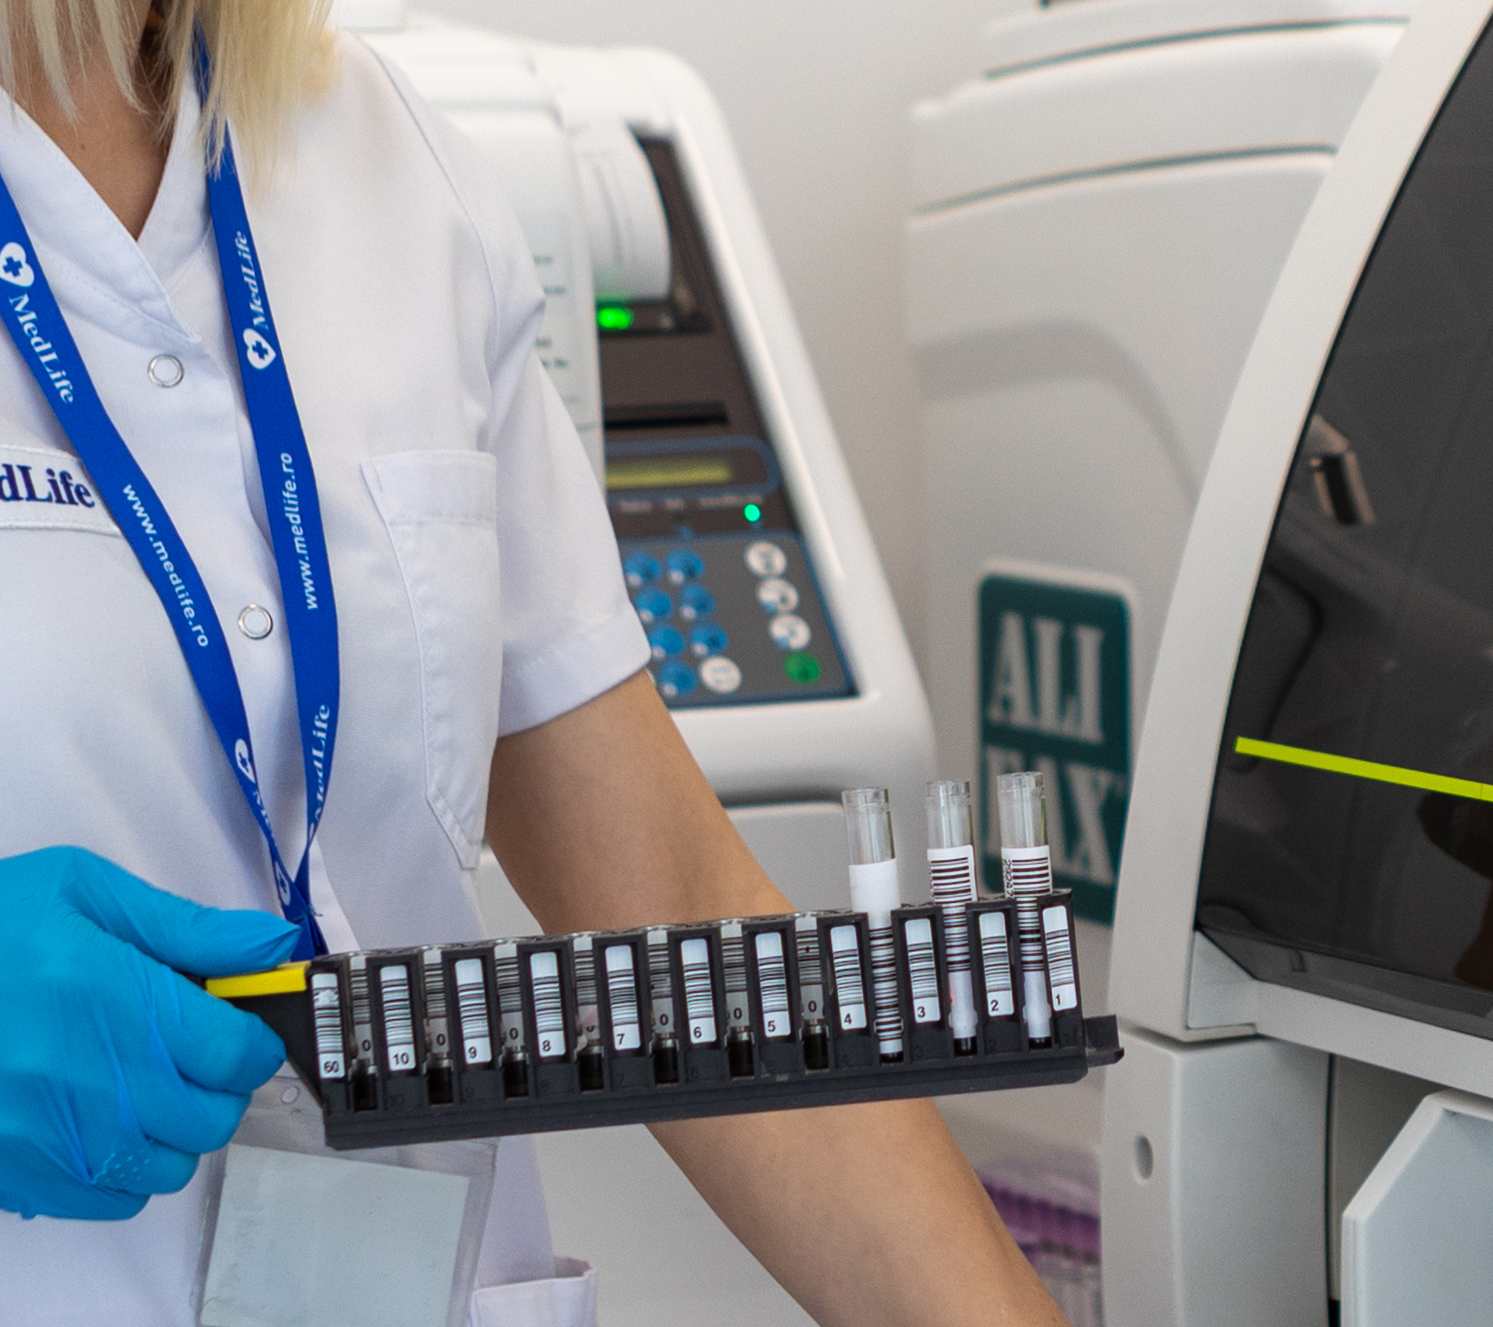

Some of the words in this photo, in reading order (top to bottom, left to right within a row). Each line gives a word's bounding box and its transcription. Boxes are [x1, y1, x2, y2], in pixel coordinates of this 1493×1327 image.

[234, 230, 270, 330] MedLife
[8, 293, 74, 405] MedLife
[281, 452, 318, 611] www.medlife.ro
[122, 483, 209, 648] www.medlife.ro
[990, 999, 999, 1011] 2
[1055, 994, 1062, 1006] 1
[917, 1006, 926, 1018] 3
[843, 1013, 853, 1025] 4
[768, 1020, 776, 1032] 5
[616, 1033, 626, 1045] 7
[693, 1027, 703, 1039] 6
[542, 1039, 552, 1052] 8
[392, 1052, 410, 1065] 10
[467, 1046, 478, 1059] 9
